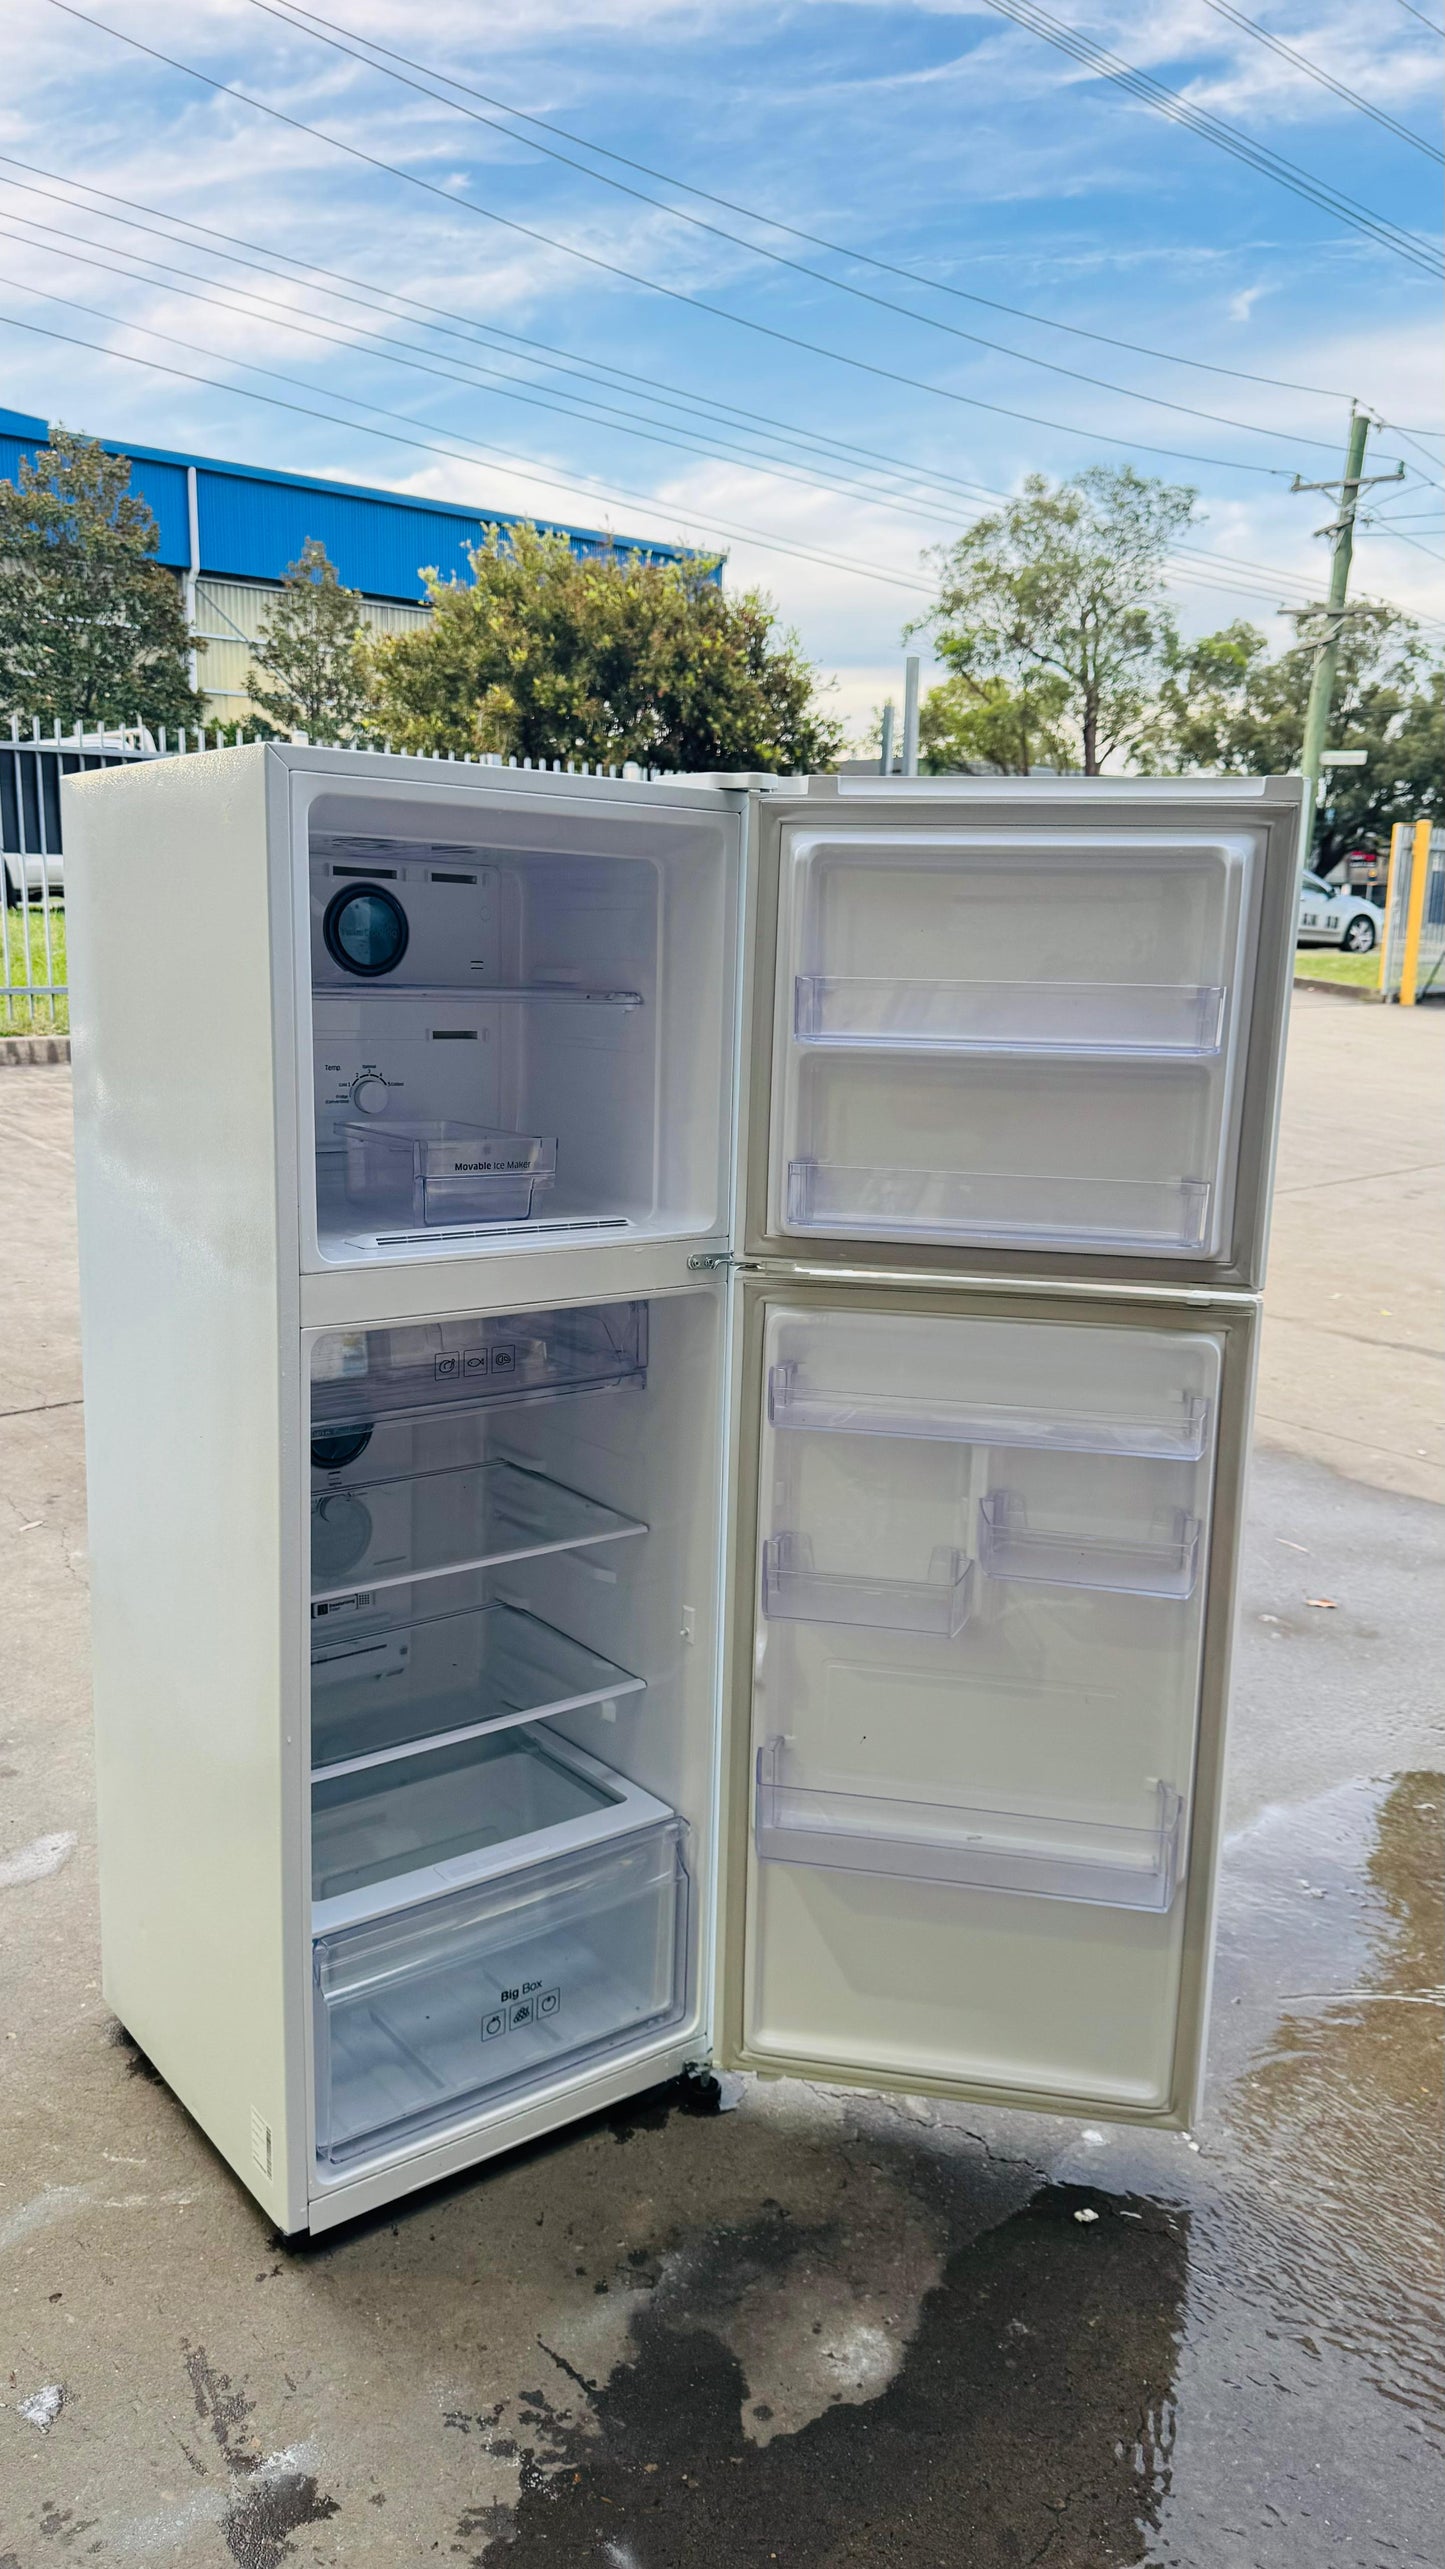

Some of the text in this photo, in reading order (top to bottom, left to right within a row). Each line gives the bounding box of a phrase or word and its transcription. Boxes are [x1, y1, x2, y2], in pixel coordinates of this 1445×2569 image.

[454, 1160, 531, 1171] Movable Ice Maker
[501, 1980, 543, 2002] Big Box
